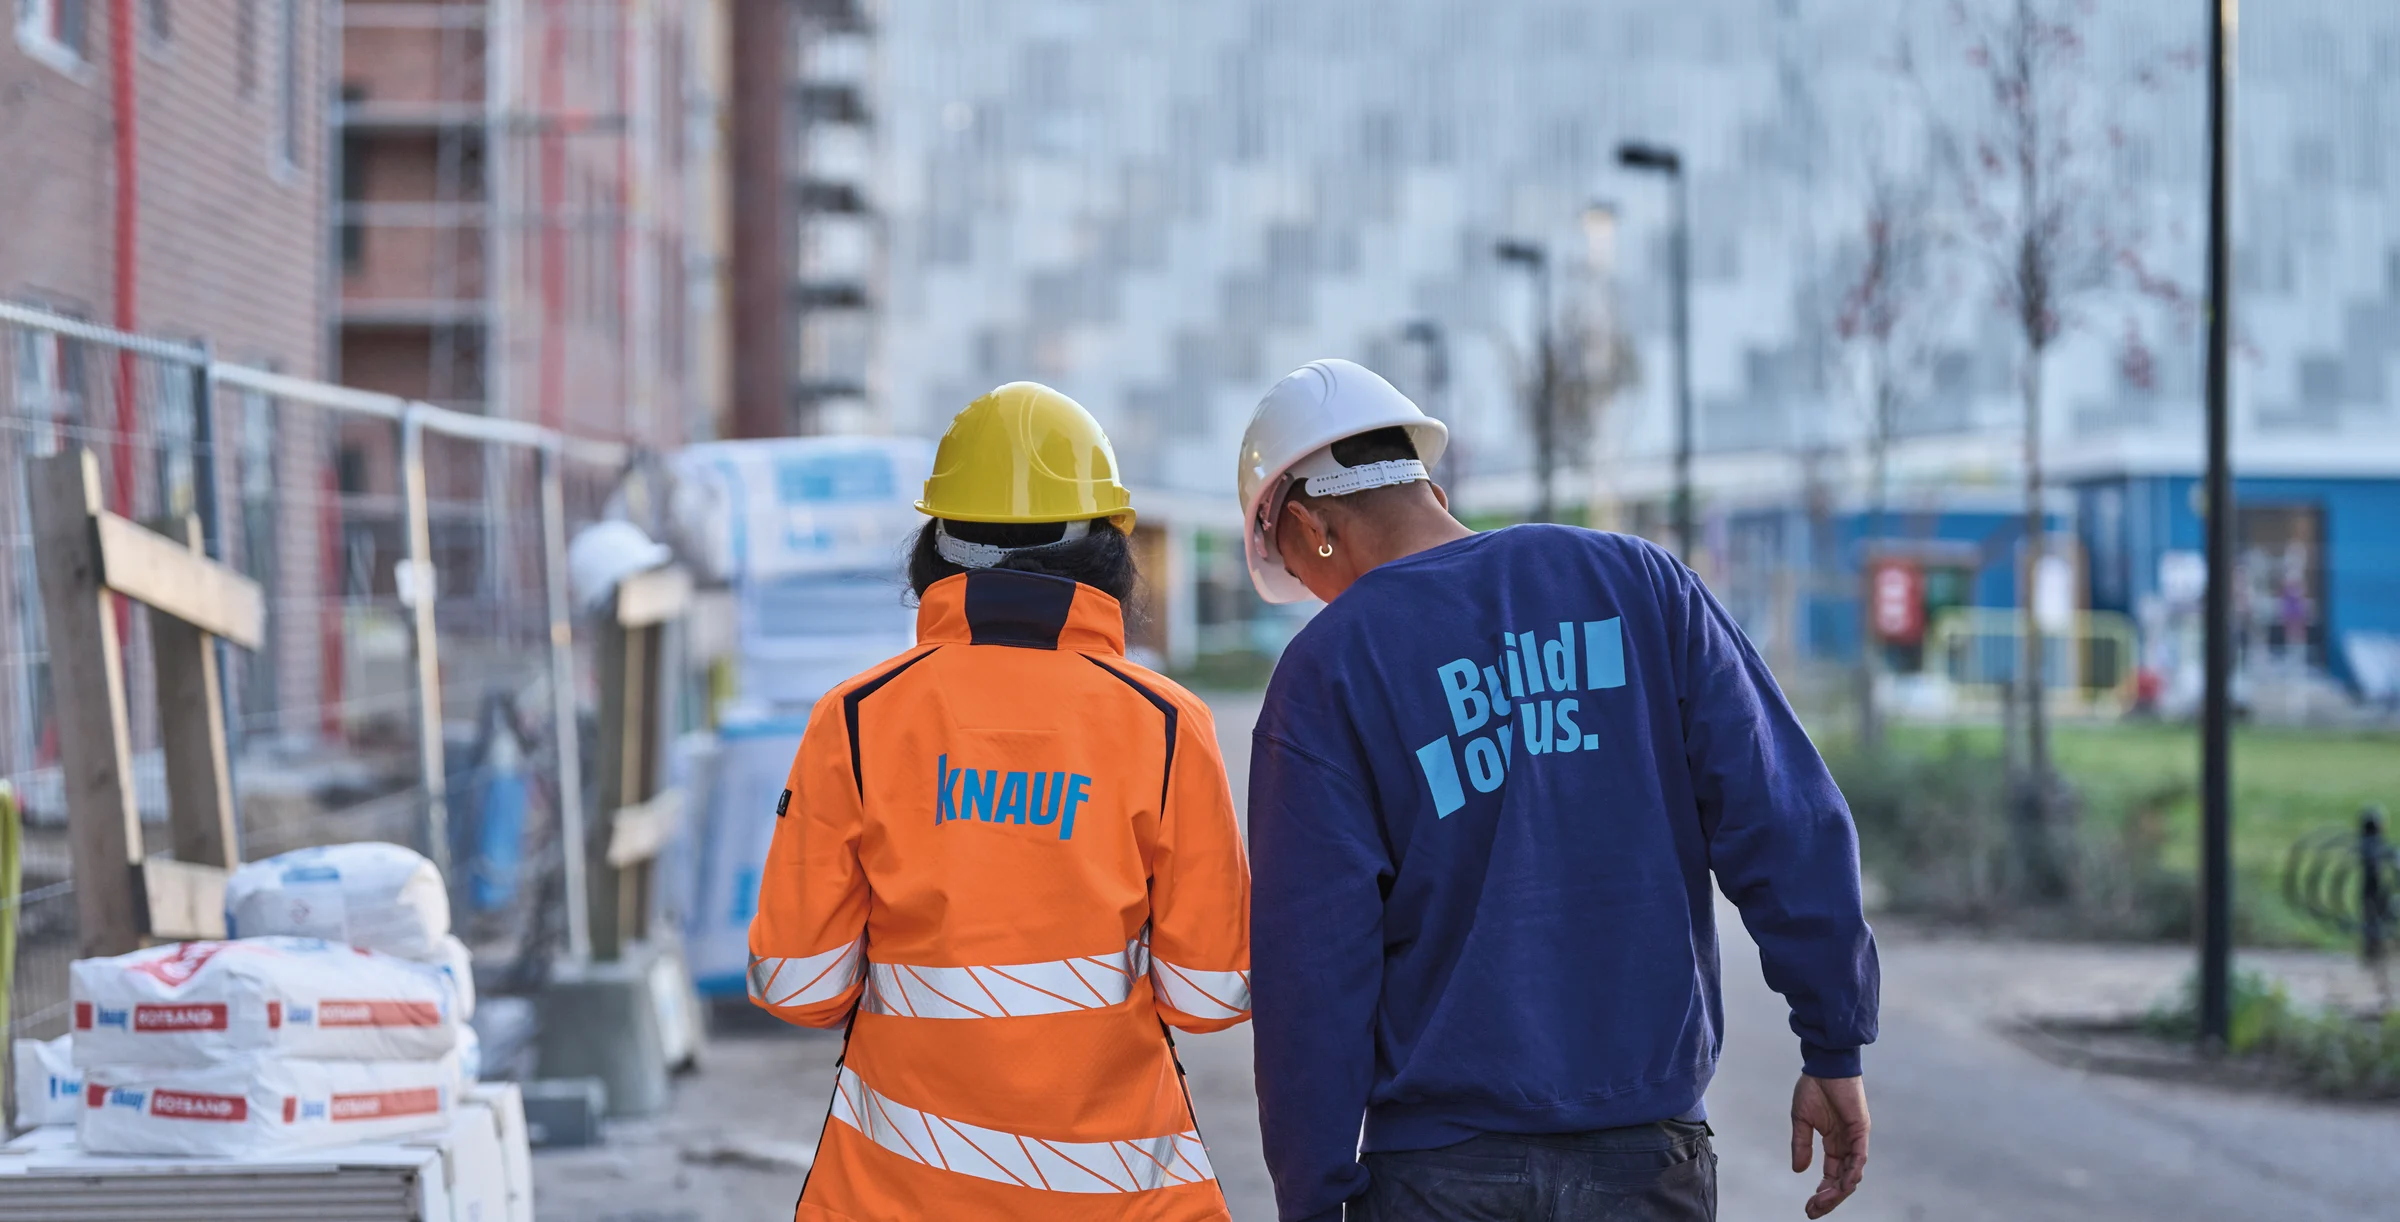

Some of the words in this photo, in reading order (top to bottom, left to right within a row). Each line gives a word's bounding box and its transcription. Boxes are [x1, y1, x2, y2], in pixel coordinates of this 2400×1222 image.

[1437, 622, 1577, 737] Build
[1520, 698, 1599, 756] us.
[934, 753, 1092, 841] KNAUF
